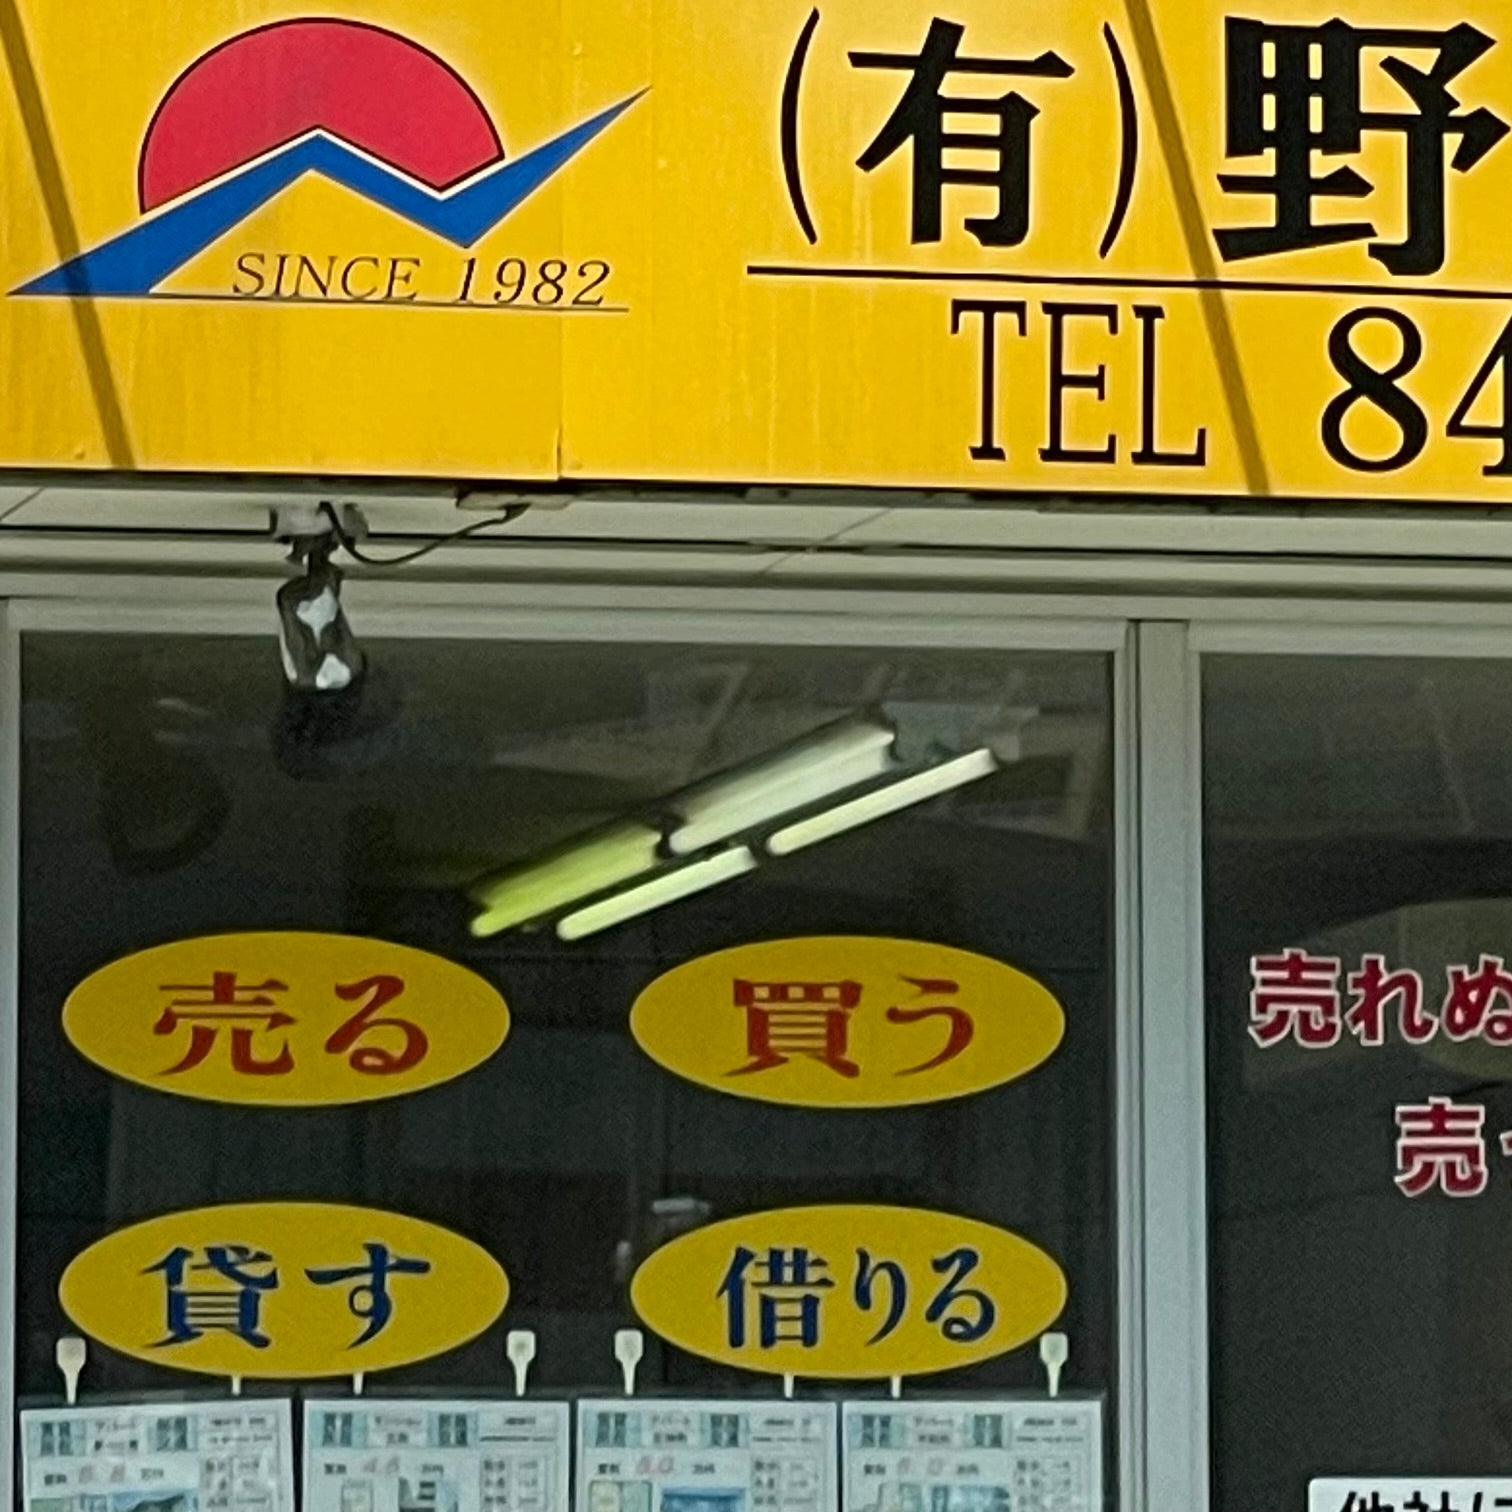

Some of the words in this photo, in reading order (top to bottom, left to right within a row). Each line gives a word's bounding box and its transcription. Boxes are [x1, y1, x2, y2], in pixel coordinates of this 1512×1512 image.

[233, 253, 421, 301] SINCE
[457, 257, 611, 306] 1982
[951, 299, 1206, 466] TEL
[154, 972, 428, 1076] 売る
[722, 975, 975, 1078] 買う
[140, 1242, 433, 1350] 貸す
[716, 1245, 997, 1349] 借りる
